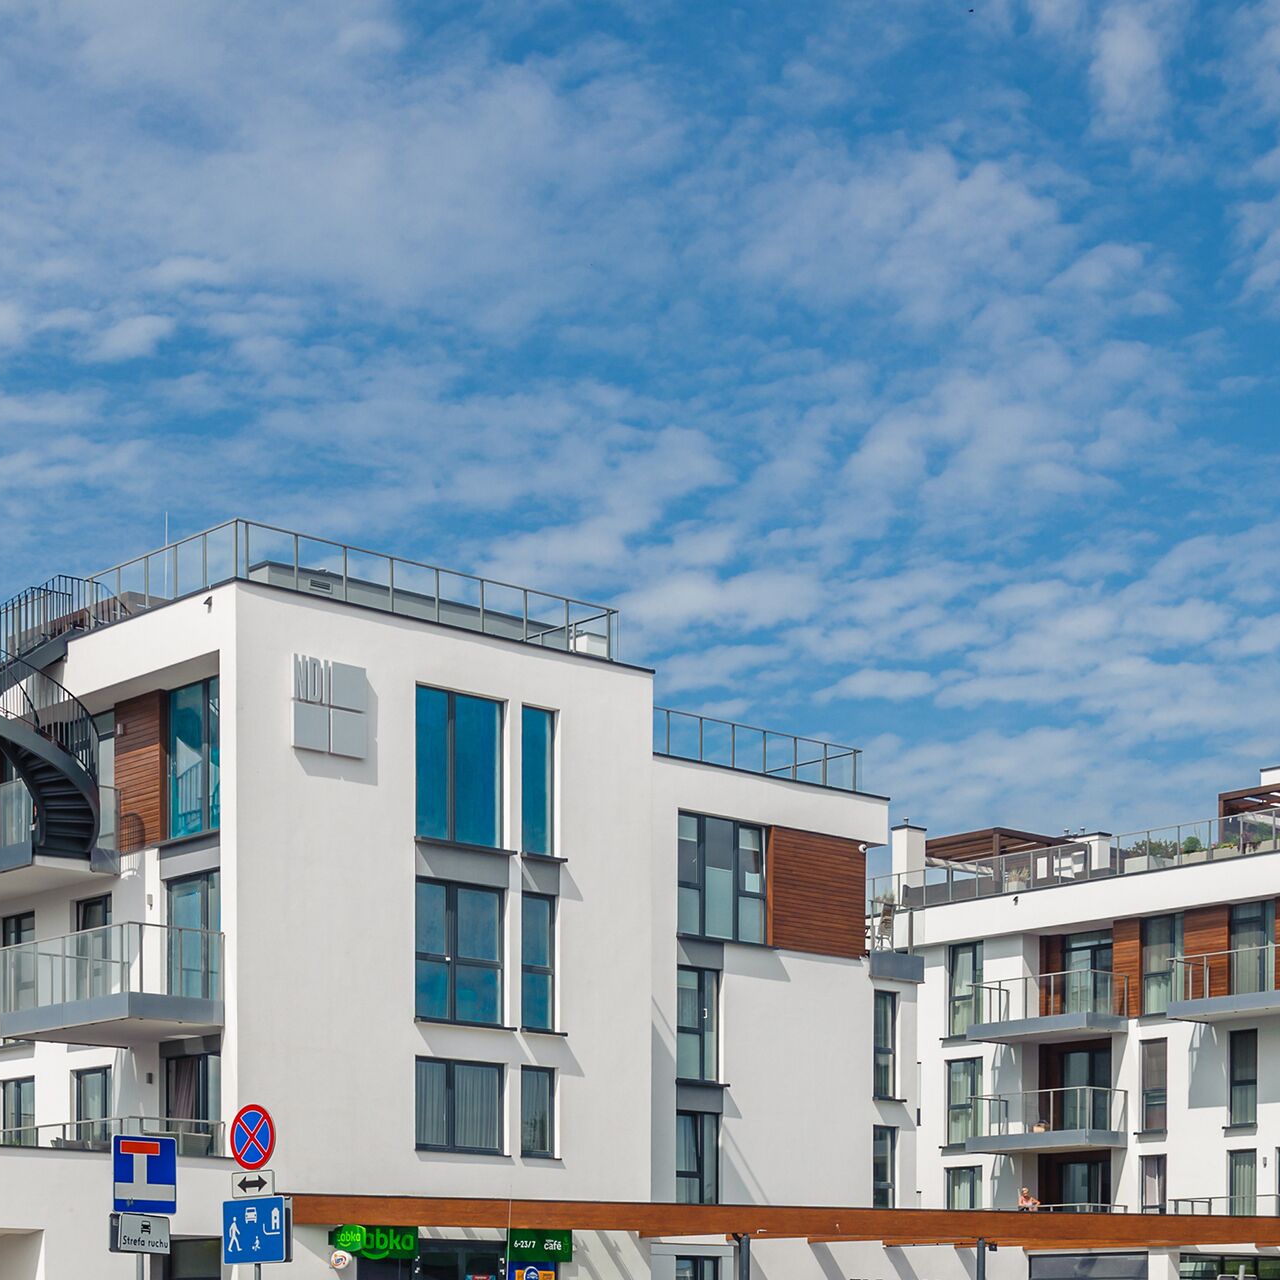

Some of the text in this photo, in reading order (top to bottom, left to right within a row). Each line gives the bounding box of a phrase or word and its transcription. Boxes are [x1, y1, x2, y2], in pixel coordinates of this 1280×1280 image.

[291, 653, 330, 705] NDI
[122, 1235, 169, 1249] Strefa ruchu
[365, 1228, 415, 1251] abka
[514, 1240, 536, 1248] 6-23/7
[544, 1240, 562, 1251] café
